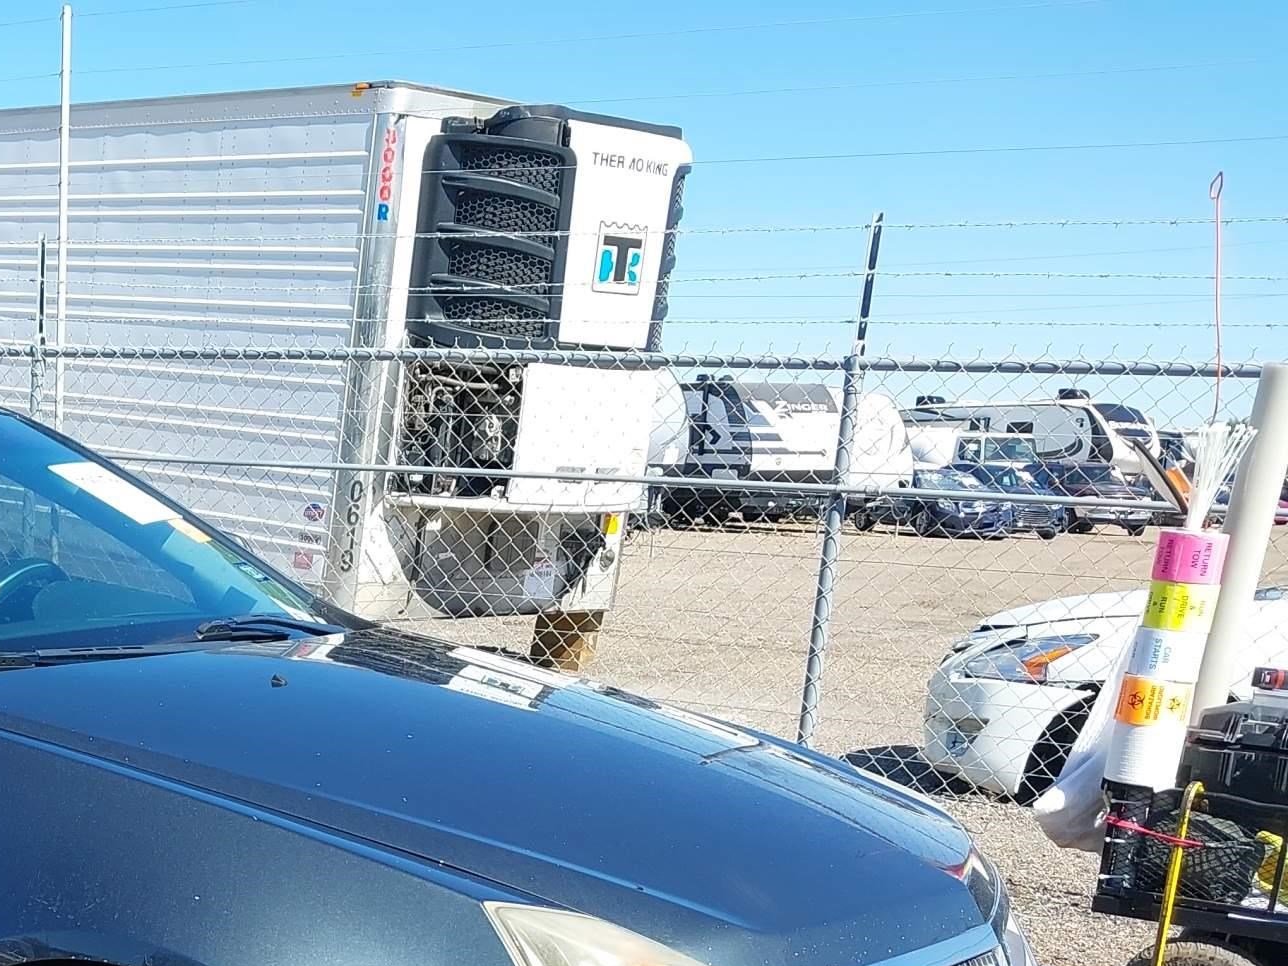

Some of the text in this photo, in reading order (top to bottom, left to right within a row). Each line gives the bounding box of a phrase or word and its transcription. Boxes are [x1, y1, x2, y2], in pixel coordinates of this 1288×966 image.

[646, 159, 669, 177] KING
[1189, 549, 1202, 571] TOW
[1199, 541, 1214, 578] RETURN
[1157, 596, 1169, 615] RUN
[1177, 595, 1189, 619] DRIVE
[1148, 638, 1164, 671] STARTS
[1161, 646, 1173, 665] CAR
